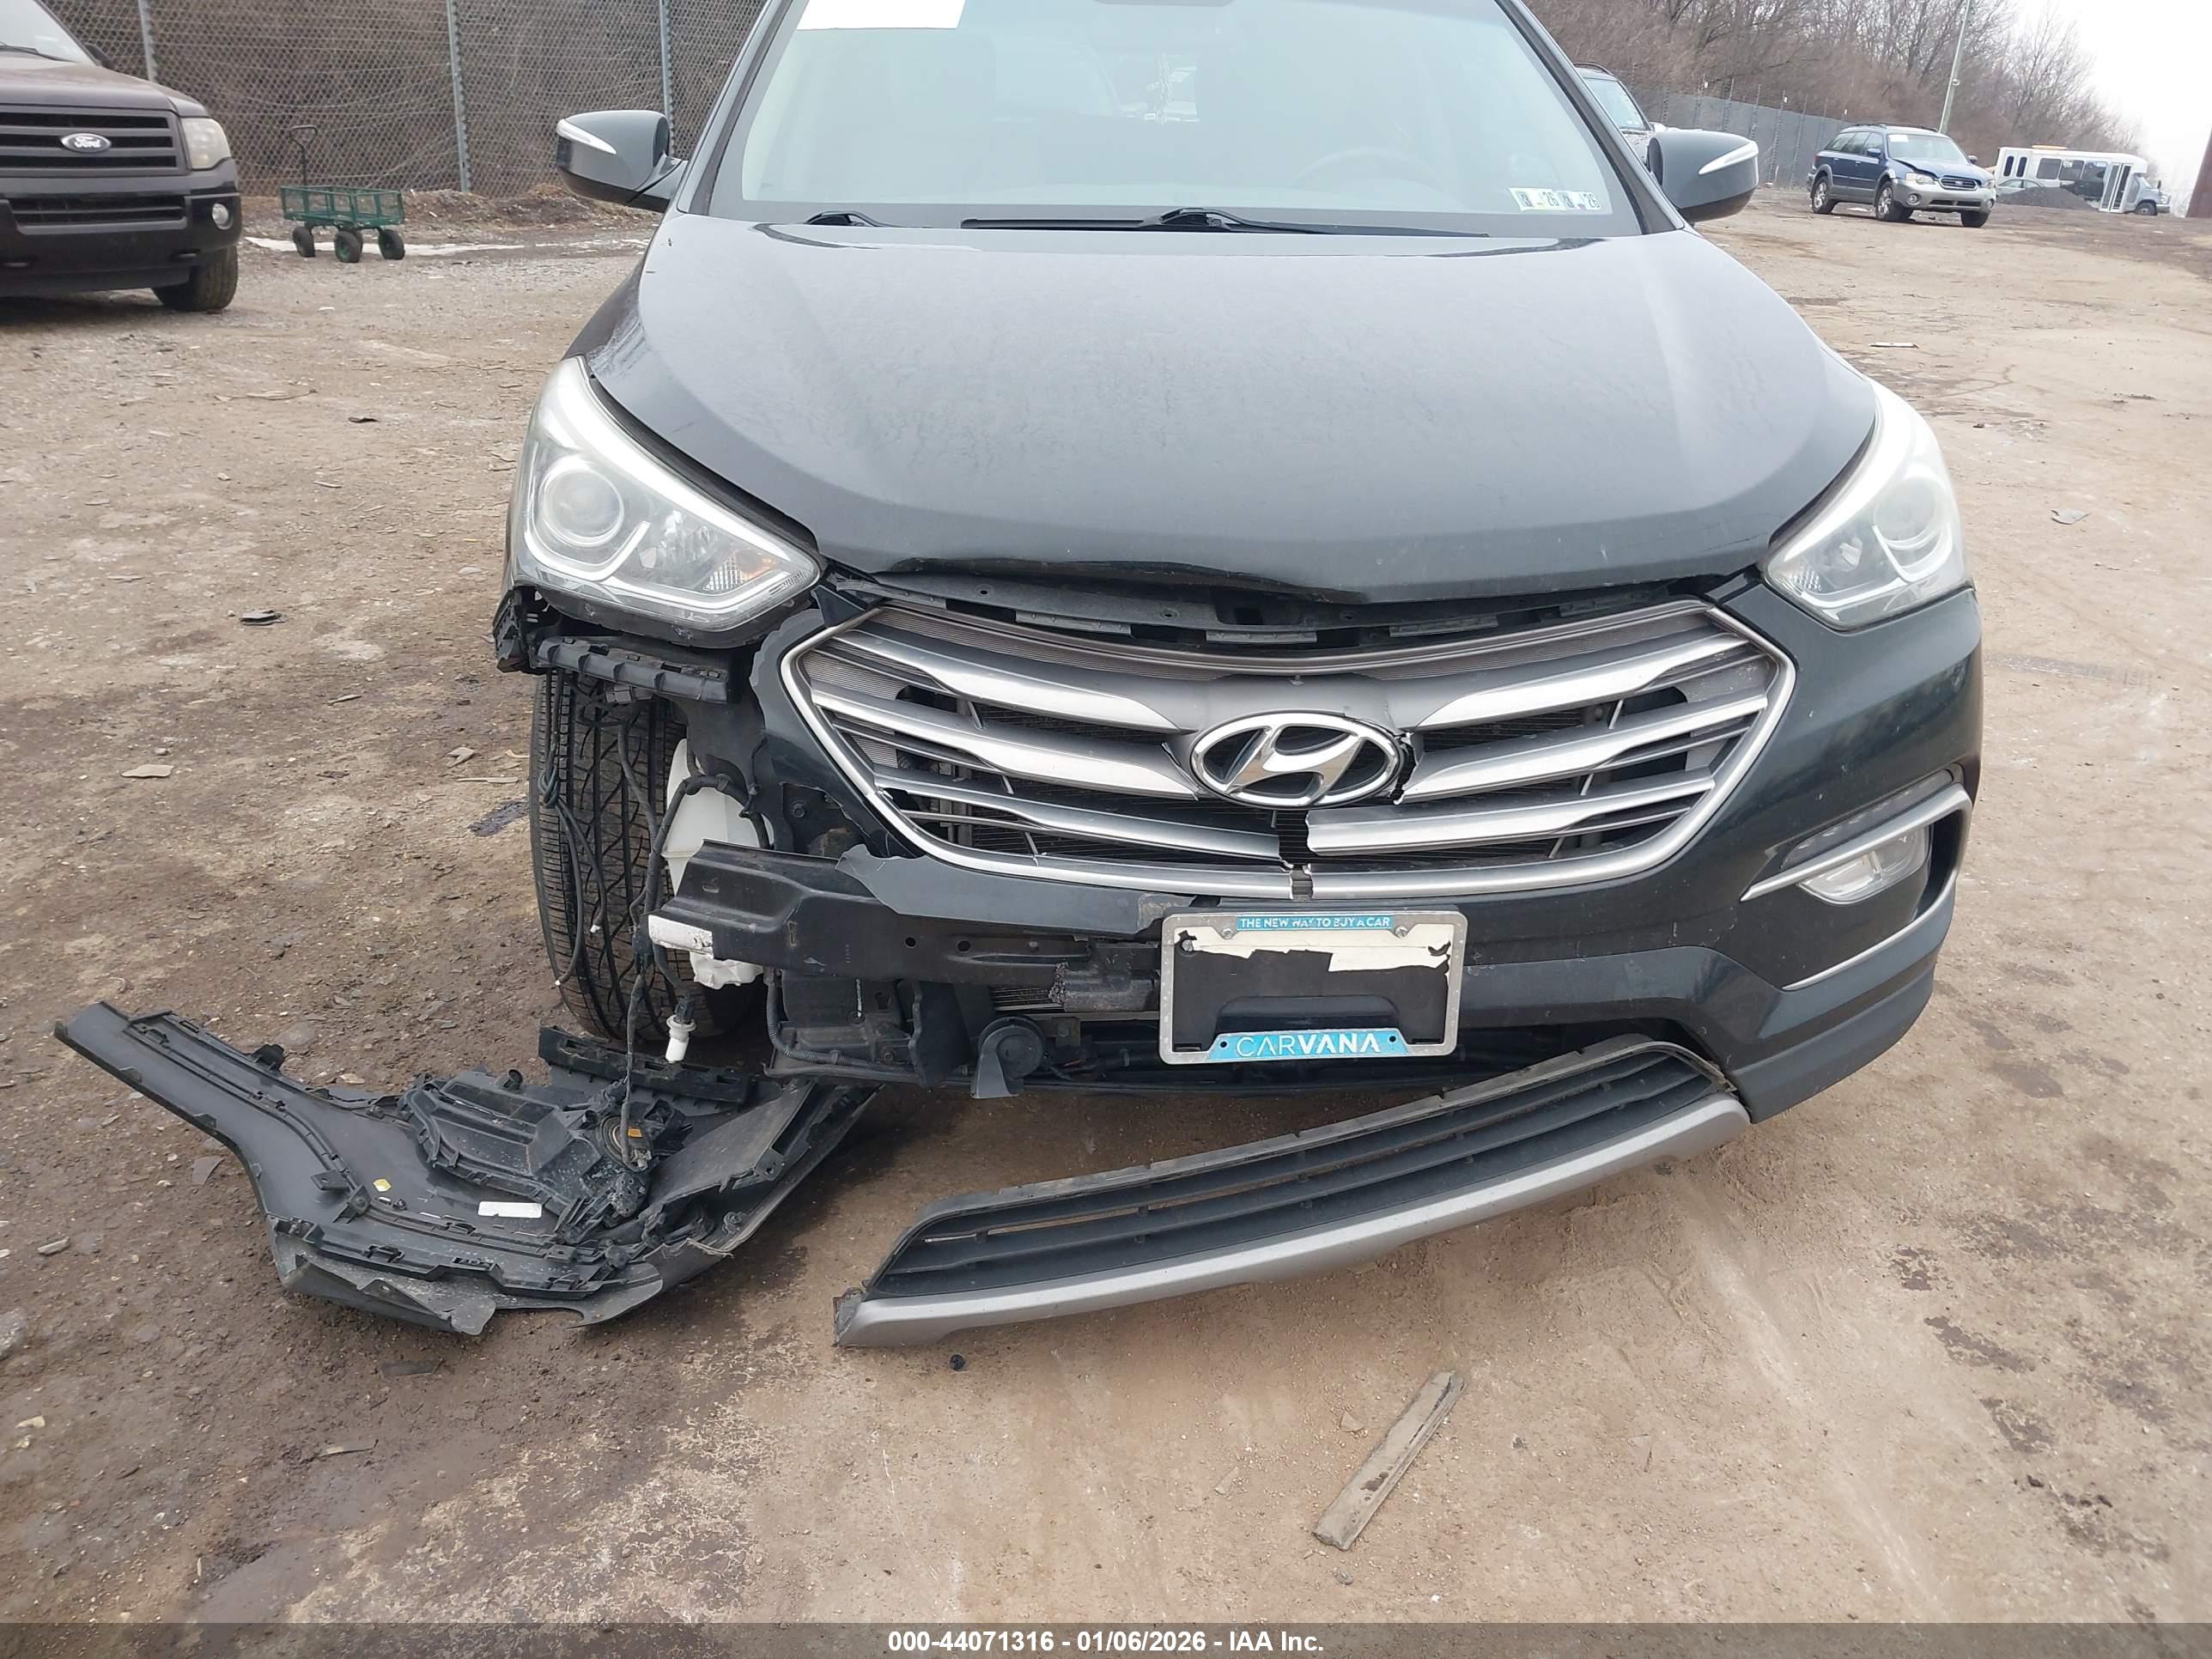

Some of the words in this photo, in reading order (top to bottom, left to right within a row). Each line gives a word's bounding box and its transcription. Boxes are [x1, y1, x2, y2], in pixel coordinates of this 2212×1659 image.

[1240, 918, 1261, 927] THE
[1264, 918, 1288, 927] NEW
[1317, 917, 1331, 927] TO
[1366, 916, 1390, 927] CAR
[1237, 1032, 1381, 1057] CARVANA
